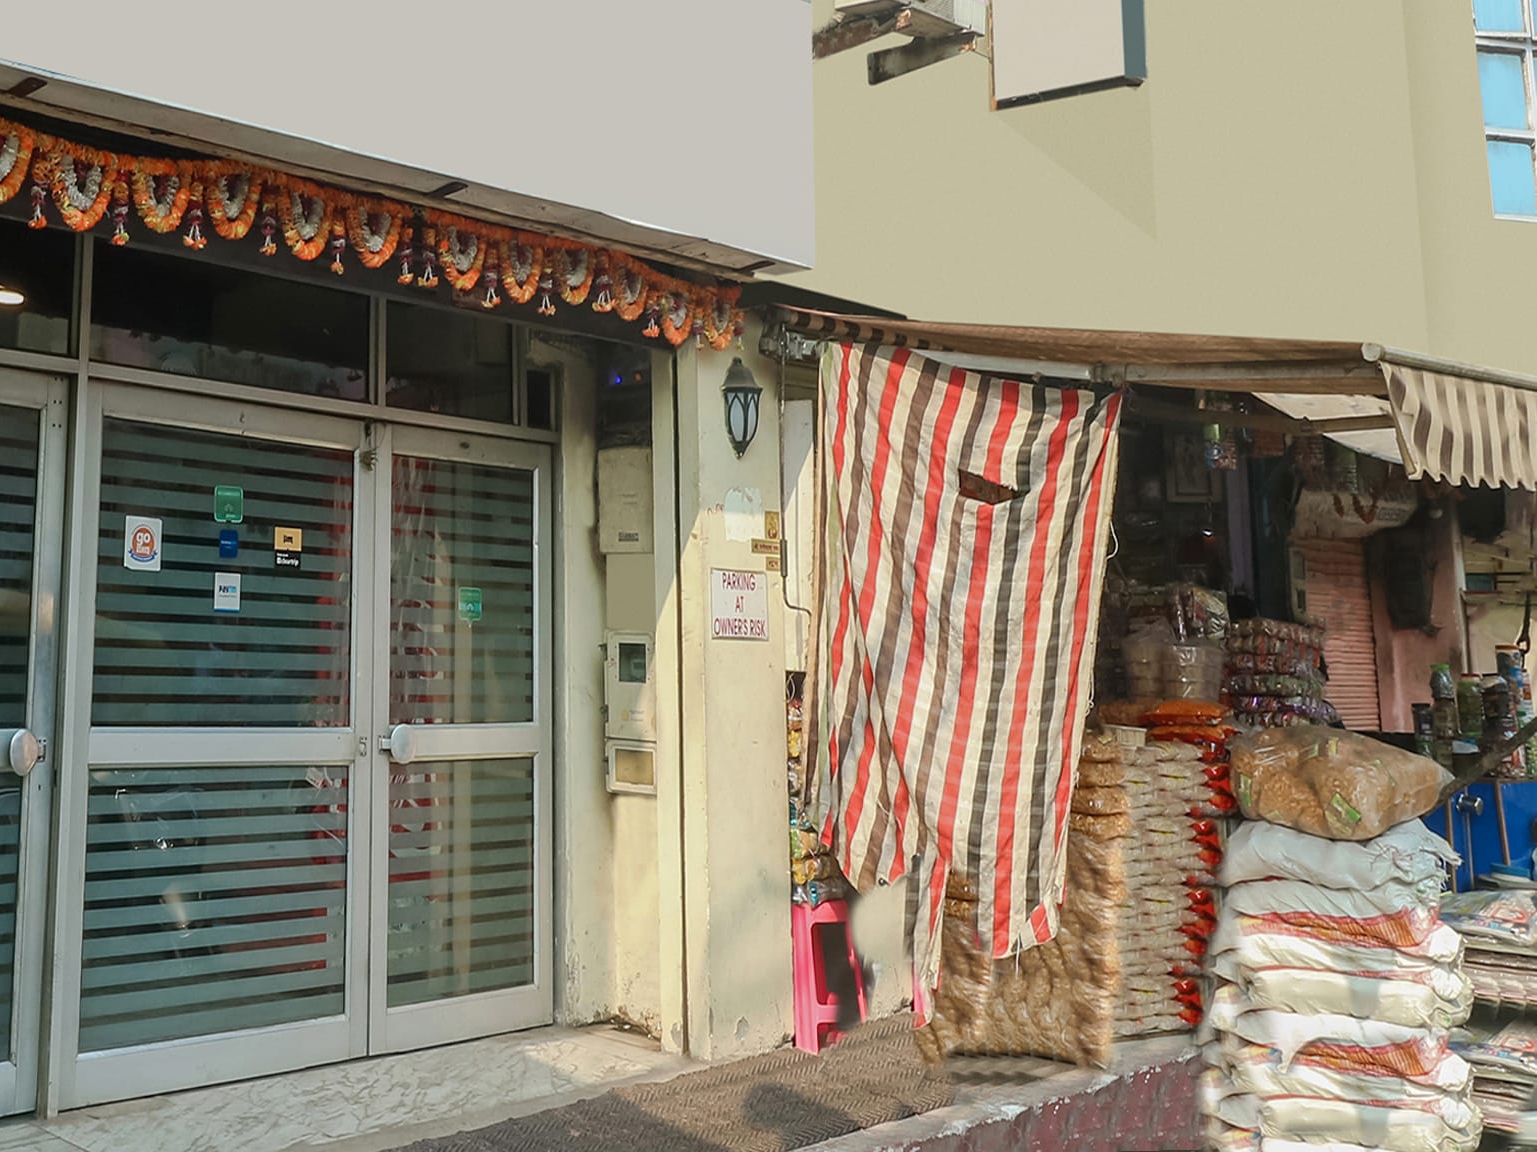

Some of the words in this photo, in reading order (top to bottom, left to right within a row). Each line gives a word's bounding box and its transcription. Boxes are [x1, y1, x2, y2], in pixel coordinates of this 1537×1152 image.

[722, 572, 756, 591] PARKING
[735, 596, 744, 613] AT
[749, 618, 766, 637] RISK
